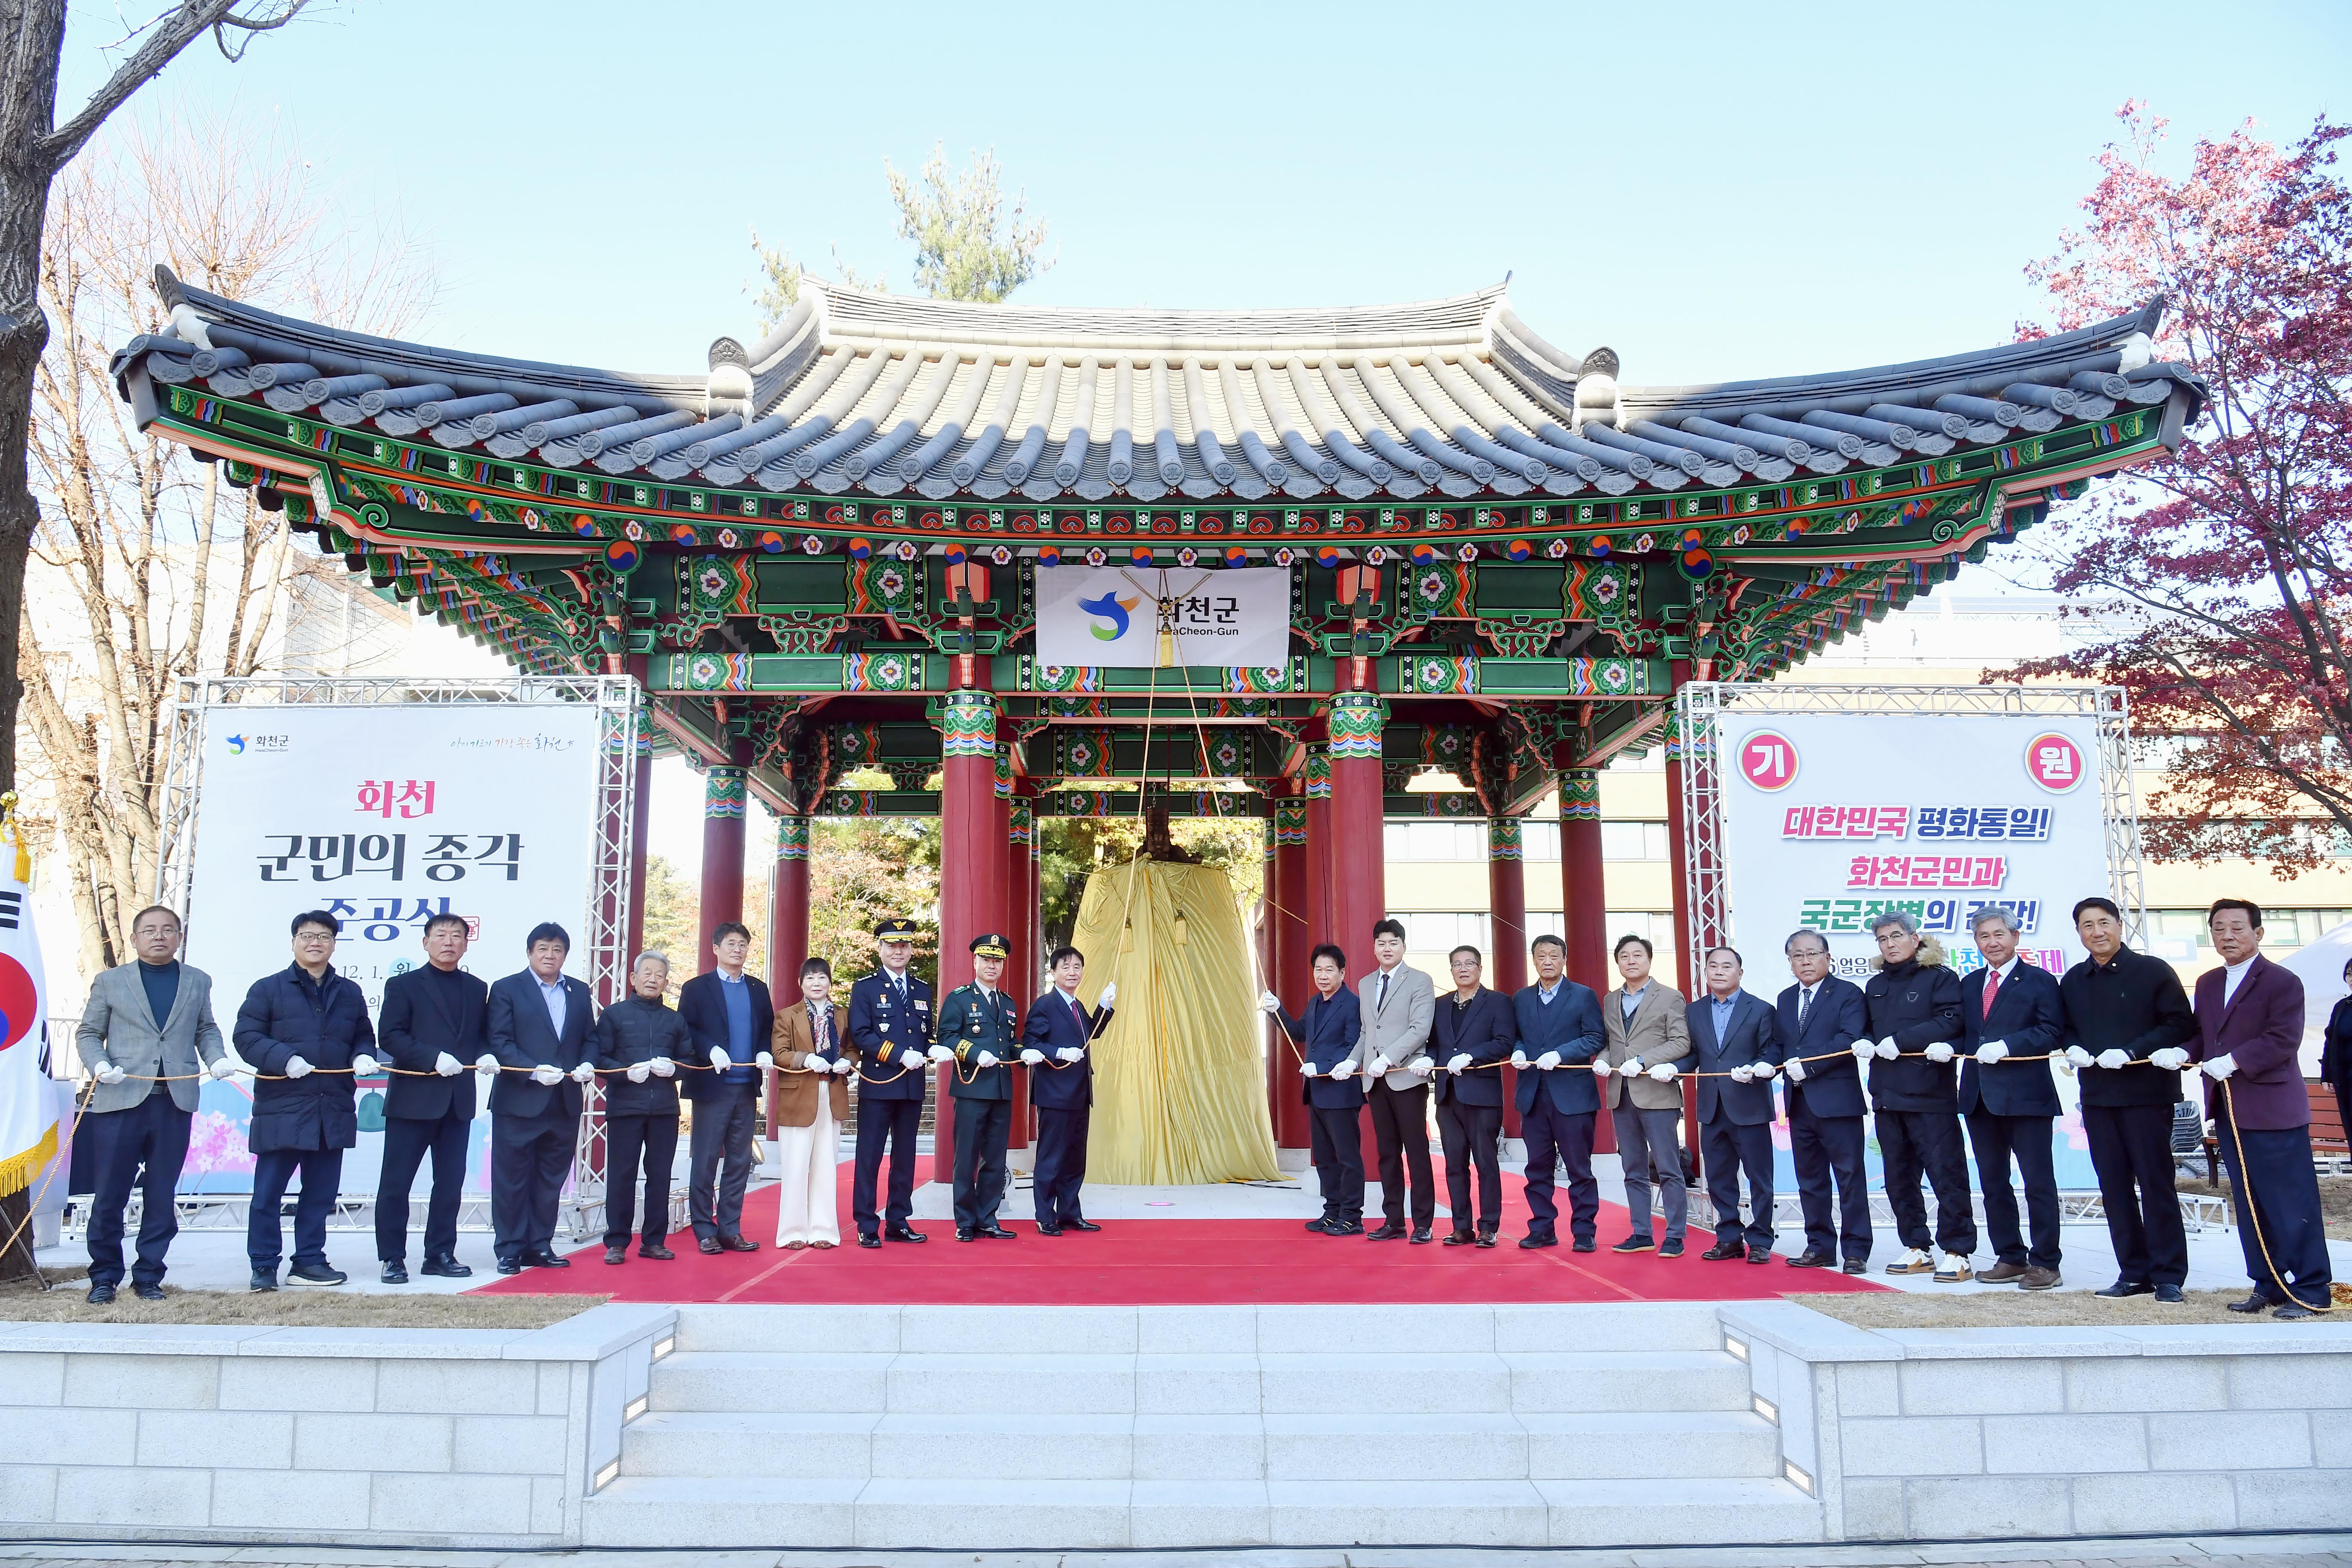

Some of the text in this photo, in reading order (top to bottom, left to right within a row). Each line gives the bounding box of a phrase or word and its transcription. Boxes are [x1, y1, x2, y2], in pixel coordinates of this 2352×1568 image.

[1156, 596, 1239, 623] 화천군
[256, 735, 289, 747] 화천군
[495, 737, 515, 749] 가장
[516, 737, 532, 750] 좋은
[535, 732, 572, 752] 화천
[1751, 744, 2073, 779] 기 원
[355, 780, 435, 819] 화천
[1782, 806, 2048, 838] 대한민국 평화통일!
[257, 834, 525, 882] 군민의 종각
[1846, 856, 2006, 887] 화천군민과
[343, 965, 363, 980] 12.
[372, 966, 383, 980] 1.
